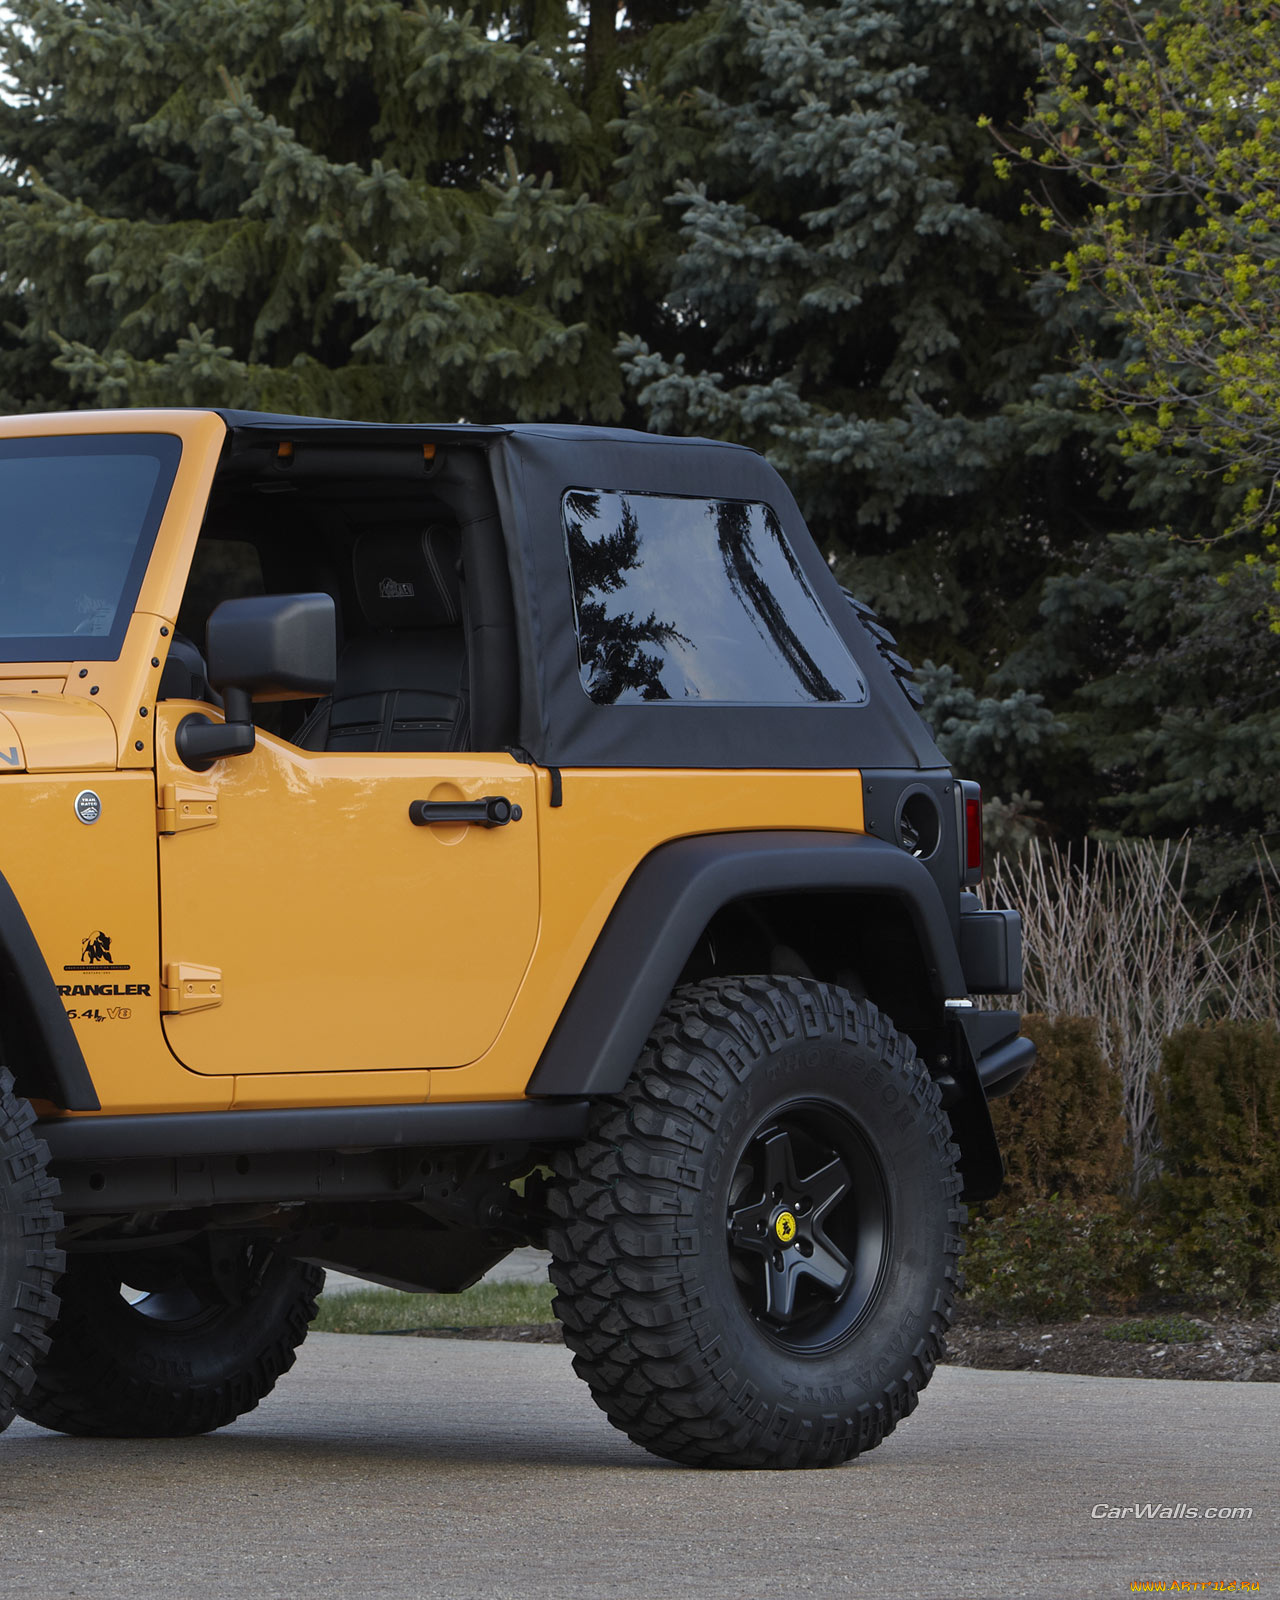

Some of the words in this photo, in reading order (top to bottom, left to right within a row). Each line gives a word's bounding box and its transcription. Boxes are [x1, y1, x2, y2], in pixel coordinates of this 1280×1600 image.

[55, 984, 151, 997] RANGLER
[106, 1006, 132, 1020] V8
[763, 1046, 917, 1136] THOMPSON
[851, 1310, 921, 1393] BAJA
[781, 1376, 847, 1402] MTZ
